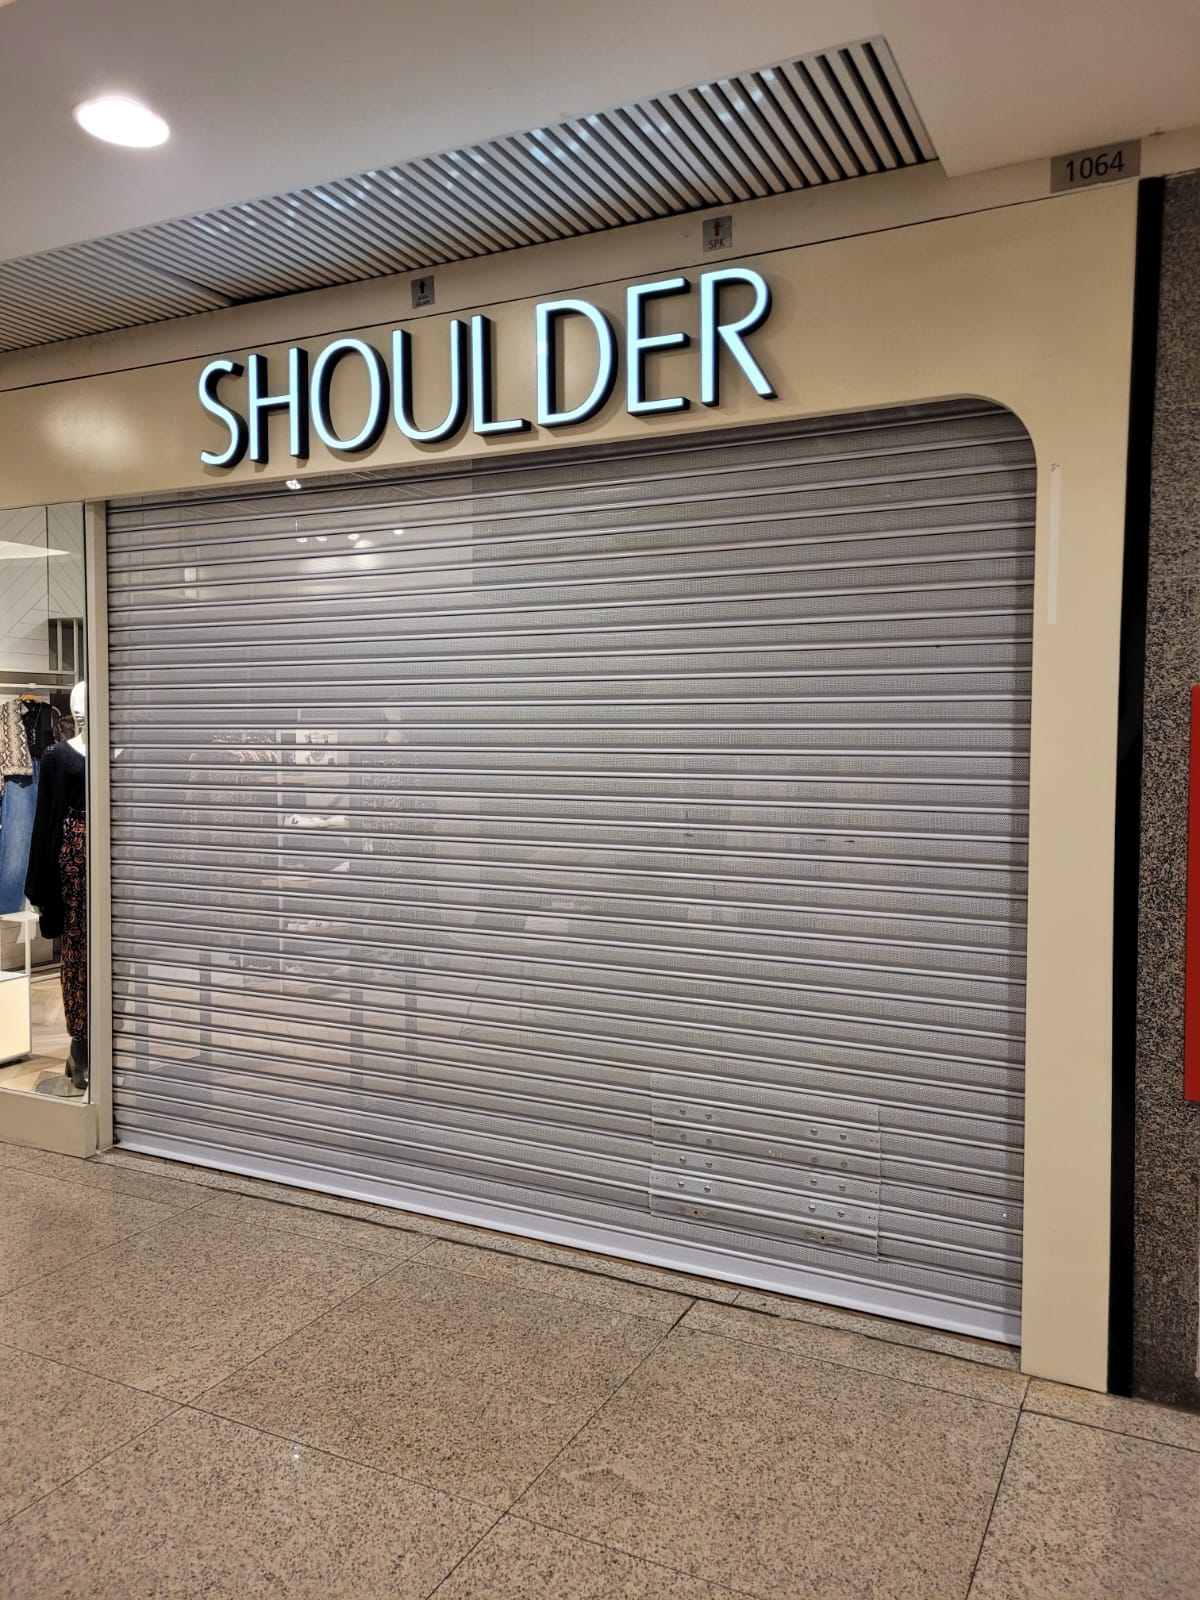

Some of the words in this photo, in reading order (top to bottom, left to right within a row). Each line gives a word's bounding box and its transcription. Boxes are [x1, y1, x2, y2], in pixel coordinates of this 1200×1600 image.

[1066, 150, 1125, 182] 1064
[708, 237, 725, 250] SPK
[198, 268, 777, 469] SHOULDER
